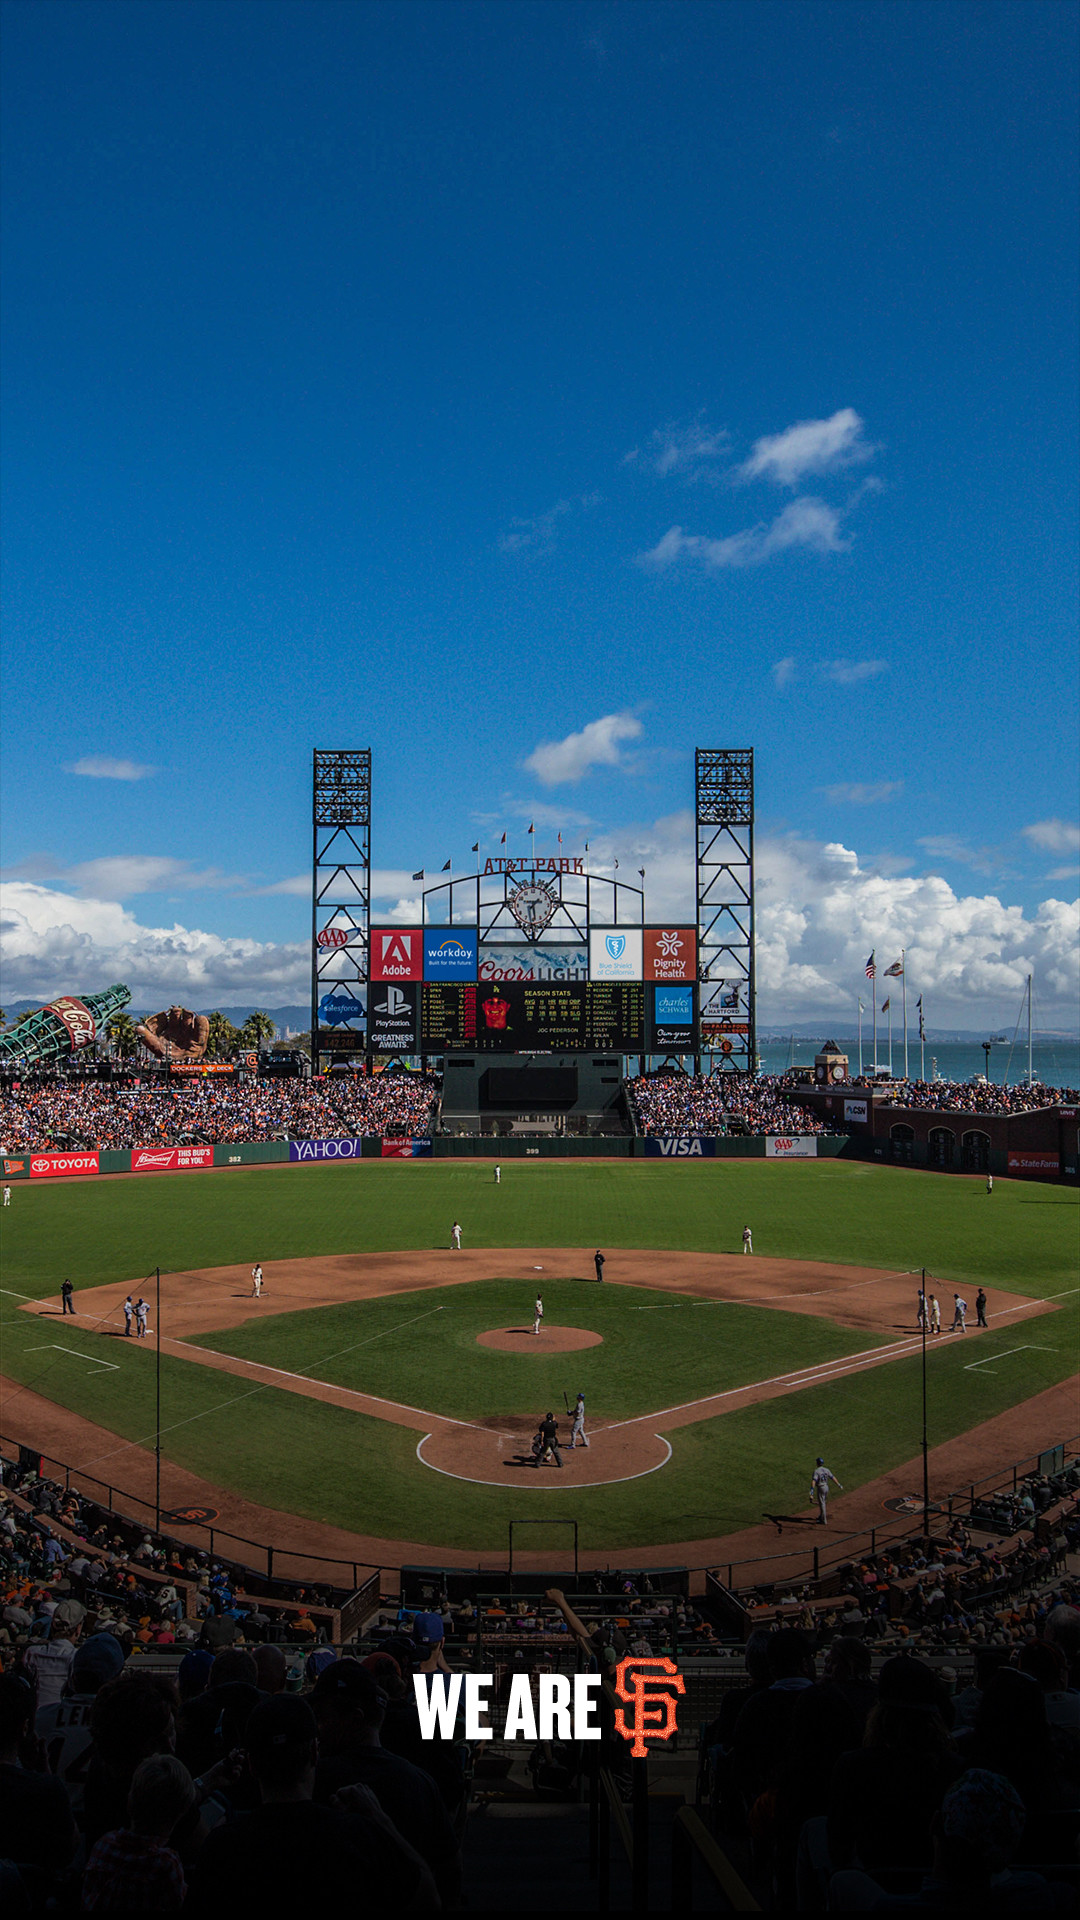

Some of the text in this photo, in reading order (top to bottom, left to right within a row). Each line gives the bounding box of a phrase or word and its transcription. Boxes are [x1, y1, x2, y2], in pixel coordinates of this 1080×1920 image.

[483, 858, 584, 876] AT&T PARK
[319, 928, 347, 947] AAA
[428, 948, 472, 958] workday
[382, 965, 411, 975] Adobe
[653, 959, 686, 970] Dignity
[479, 960, 588, 981] Coors LIGHT
[655, 969, 685, 978] Health
[659, 998, 688, 1007] charles
[853, 1107, 866, 1115] CSN
[294, 1139, 357, 1160] YAHOO!
[655, 1139, 702, 1155] VISA
[775, 1138, 792, 1150] AAA
[51, 1158, 98, 1170] TOYOTA
[139, 1155, 171, 1164] Budweiser
